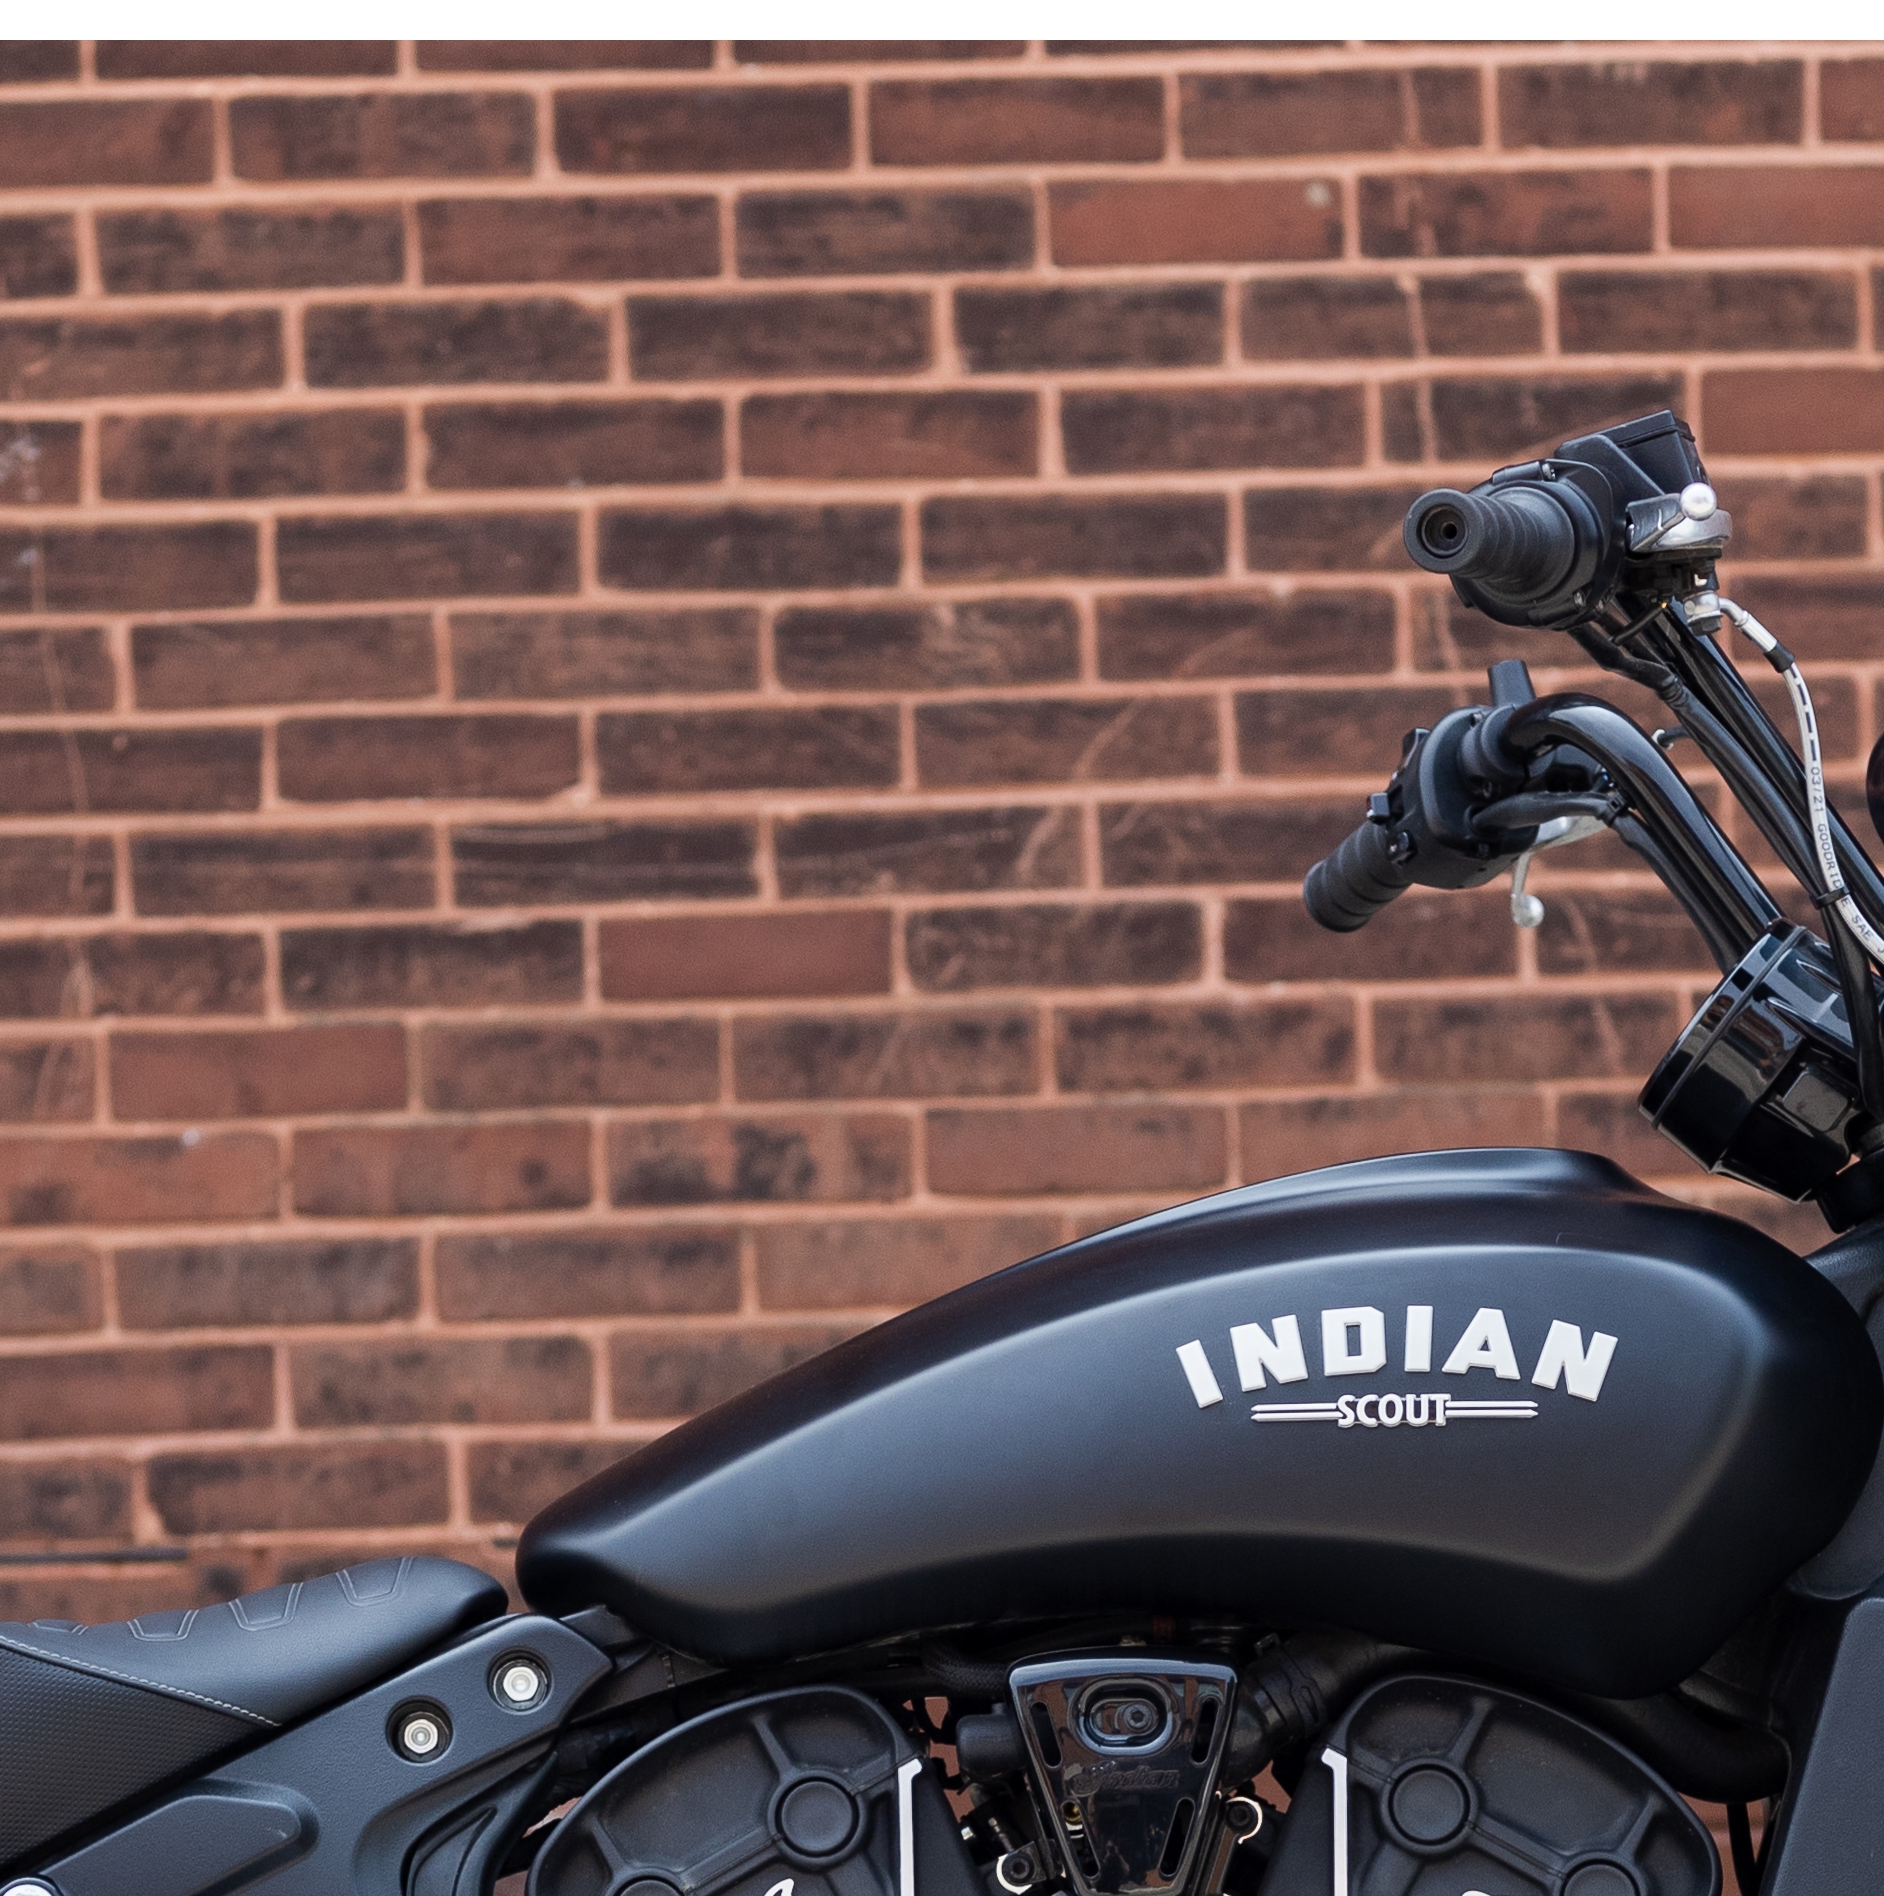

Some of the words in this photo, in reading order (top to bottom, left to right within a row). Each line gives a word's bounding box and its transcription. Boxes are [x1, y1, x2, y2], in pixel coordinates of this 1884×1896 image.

[1810, 766, 1824, 813] 03/21
[1817, 822, 1852, 908] GOODRIDE
[1851, 910, 1874, 939] SAE
[1175, 1305, 1618, 1408] INDIAN
[1337, 1393, 1452, 1428] SCOUT
